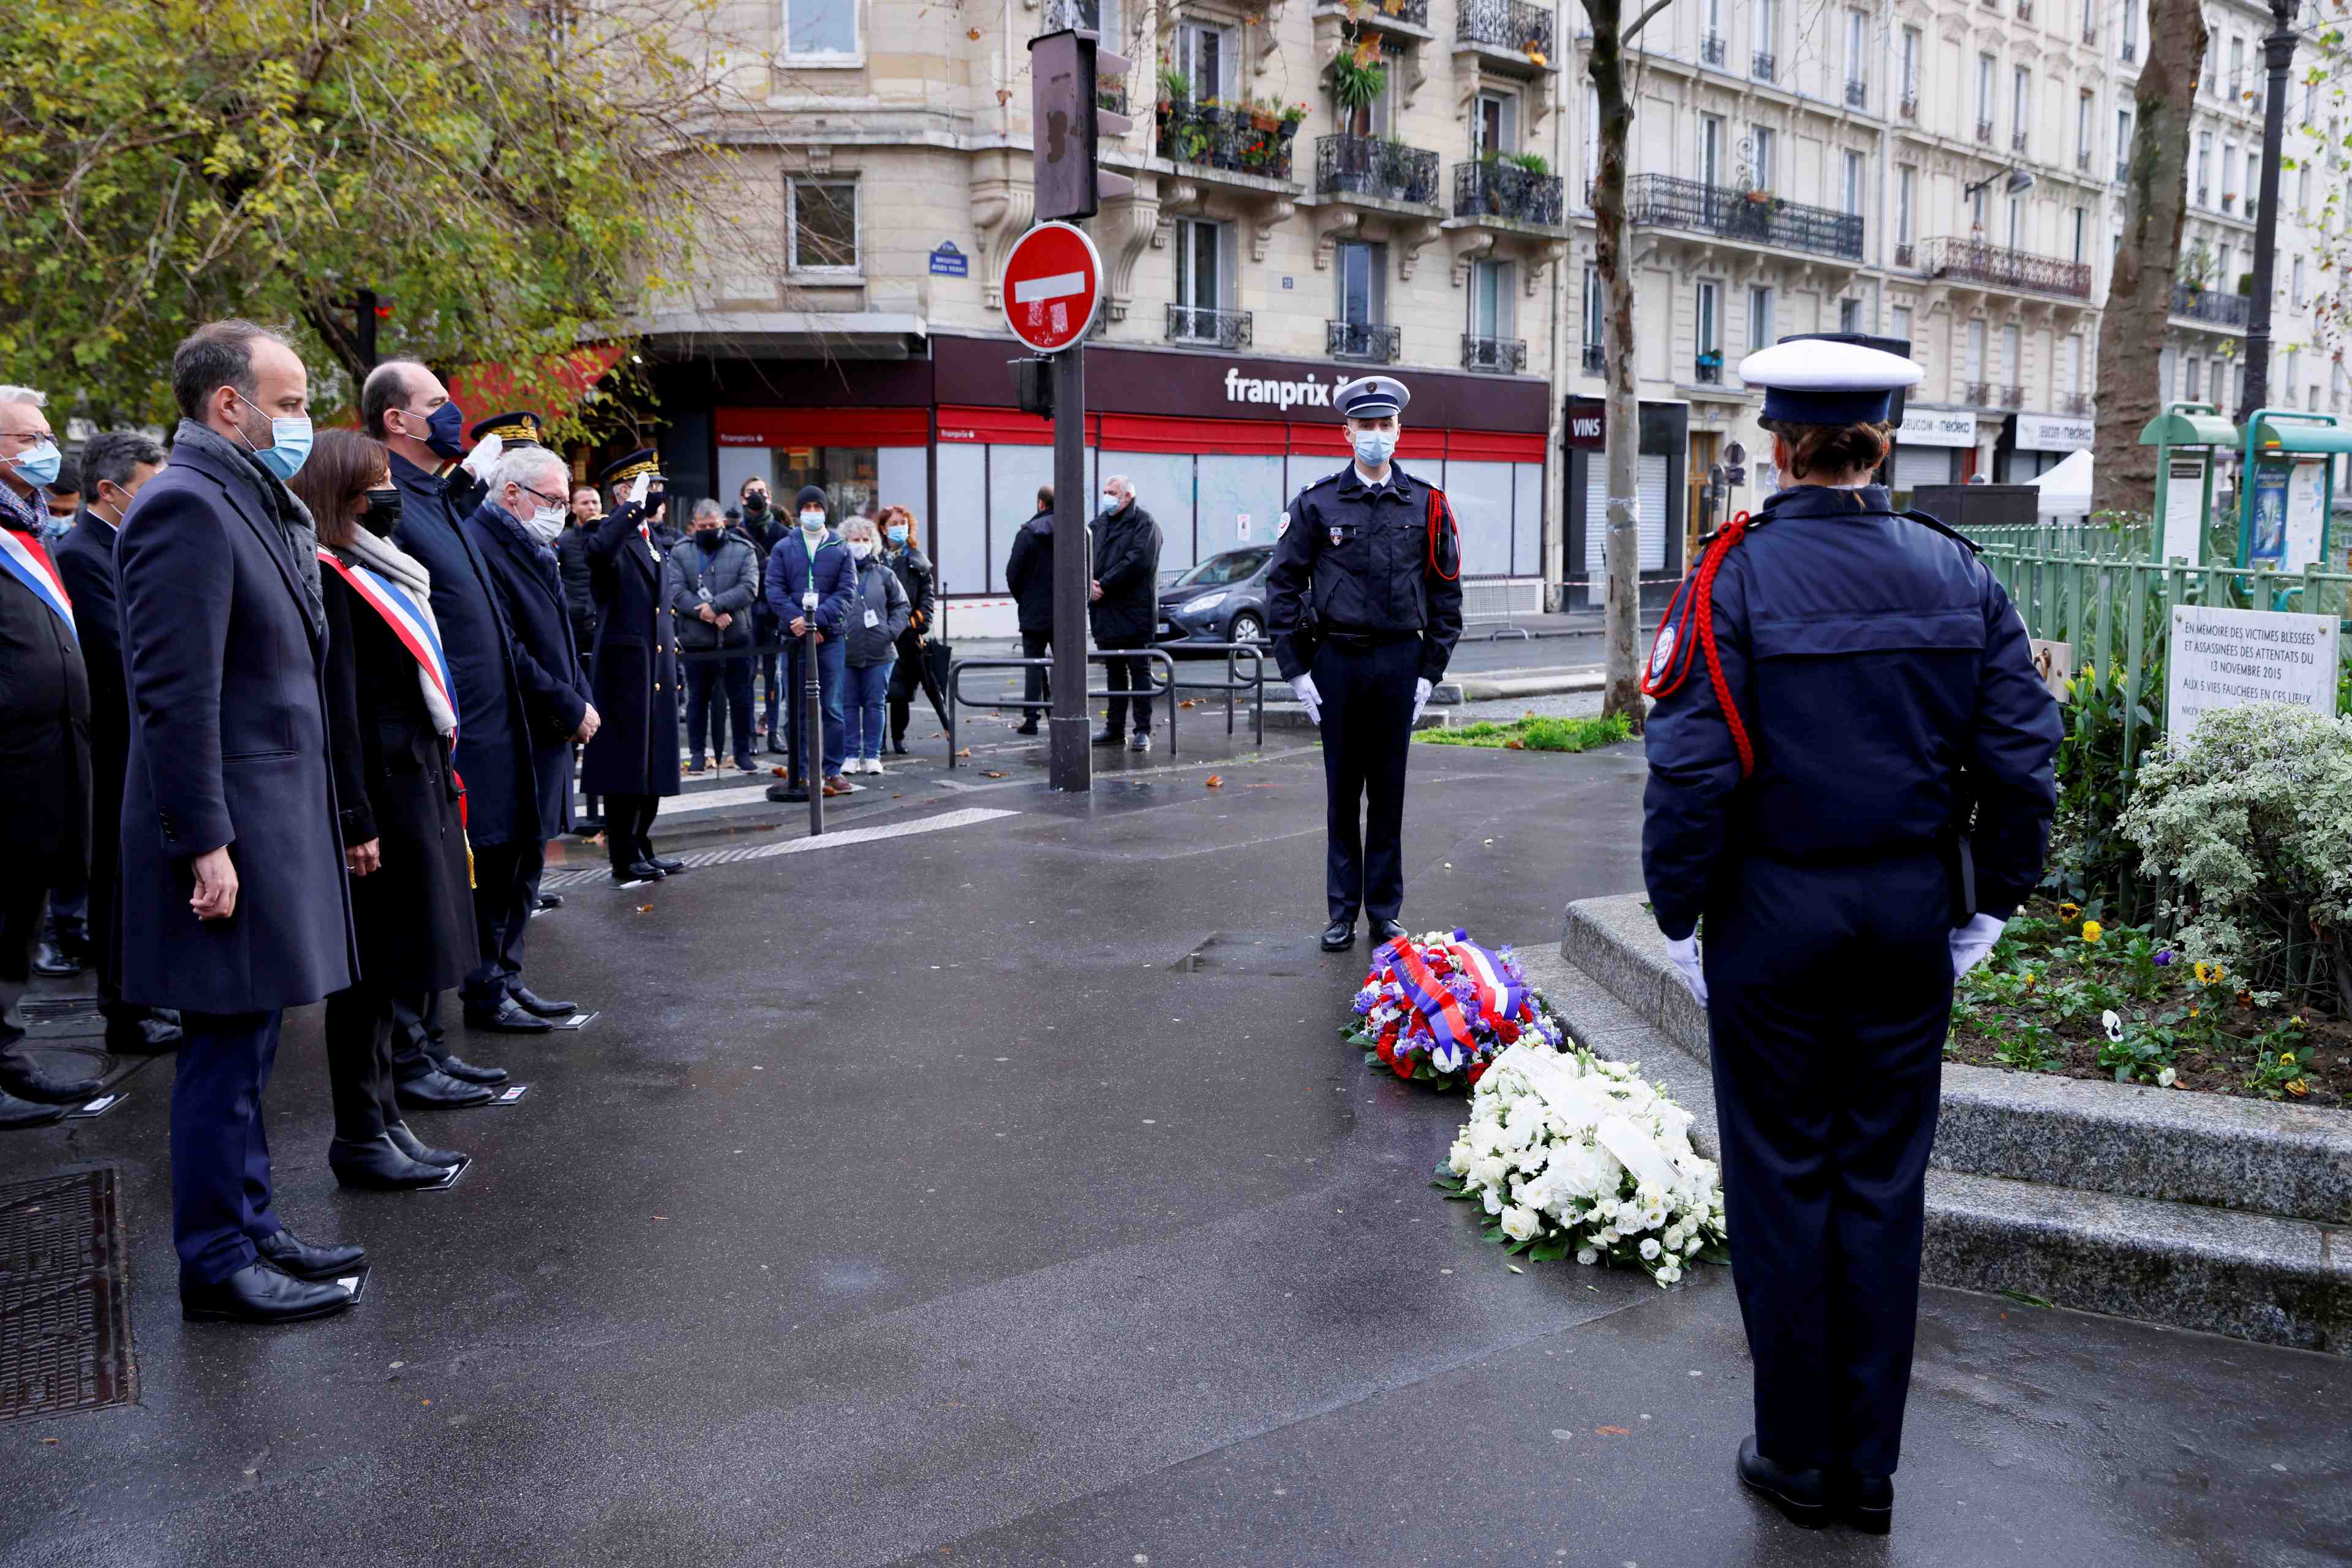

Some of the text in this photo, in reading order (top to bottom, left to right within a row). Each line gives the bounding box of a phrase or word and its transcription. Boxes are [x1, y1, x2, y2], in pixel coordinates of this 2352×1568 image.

[1225, 368, 1329, 411] franprix
[1572, 418, 1600, 437] VINS
[2185, 622, 2315, 645] EN MÉMOIRE DES VICTIMES BLESSÉES
[2185, 641, 2313, 665] ET ASSASSINÉES DES ATTENTATS DU
[2211, 661, 2282, 680] 13 NOVEMBRE 2015
[2183, 677, 2198, 690] AUX
[2200, 680, 2205, 691] 5
[2207, 681, 2220, 693] VIES
[2223, 683, 2258, 699] FAUCHÉES
[2261, 689, 2270, 699] EN
[2272, 690, 2286, 702] CES
